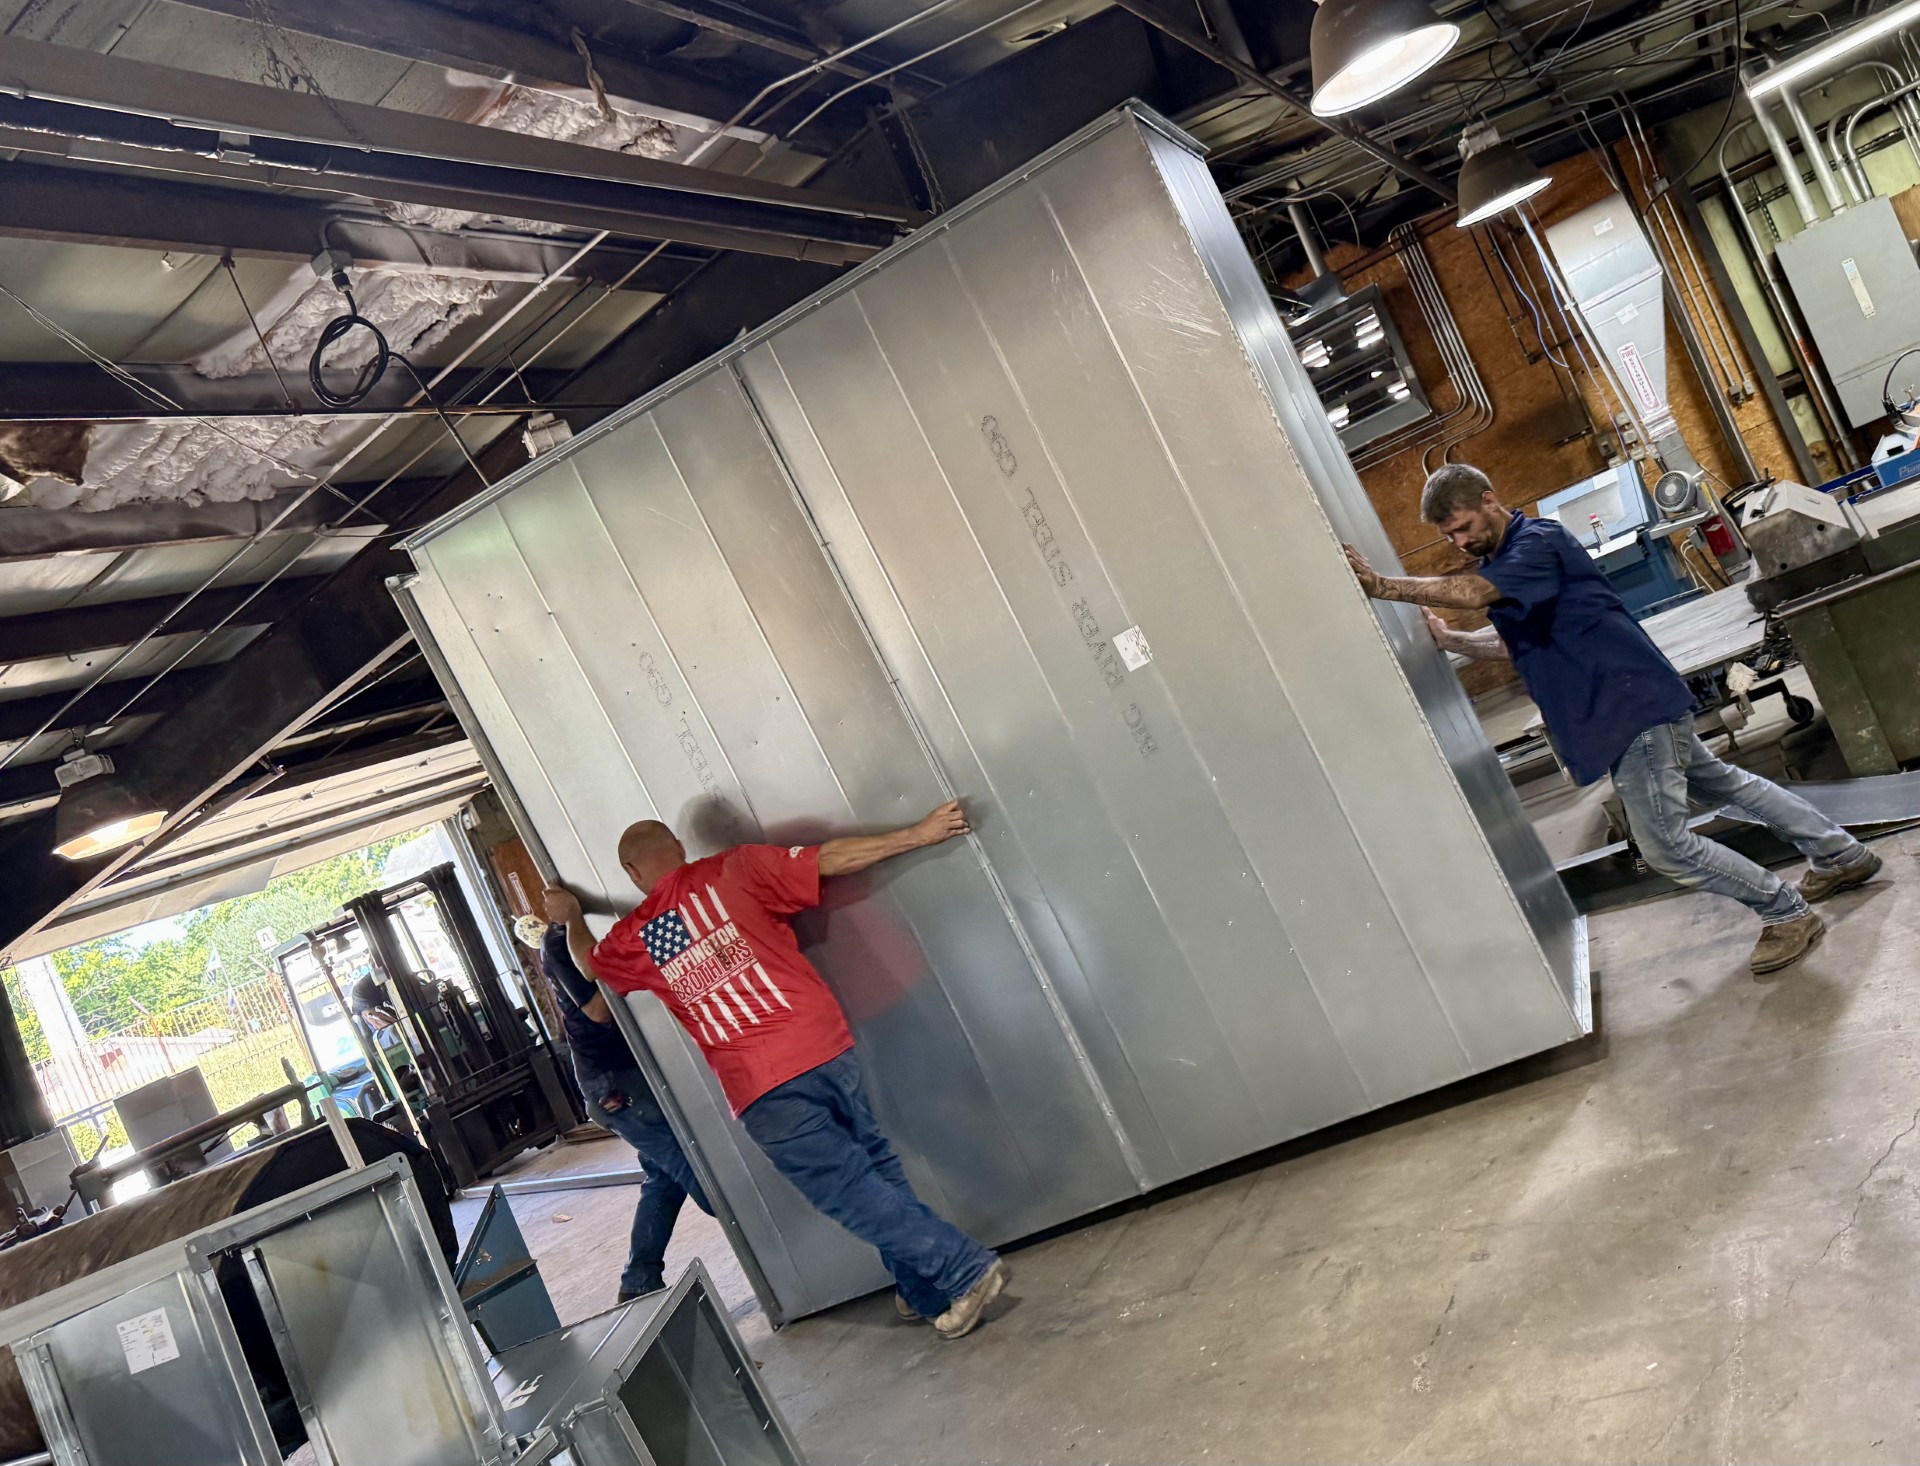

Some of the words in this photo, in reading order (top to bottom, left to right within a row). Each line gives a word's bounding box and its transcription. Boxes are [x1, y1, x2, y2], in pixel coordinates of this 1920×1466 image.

[1621, 349, 1636, 359] FIRE
[981, 415, 1017, 477] G90
[1020, 486, 1074, 587] STEEL
[1071, 597, 1124, 690] RIVER
[675, 717, 728, 804] STEEL
[659, 921, 740, 985] BUFFINGTON
[670, 937, 753, 1004] BROTHERS
